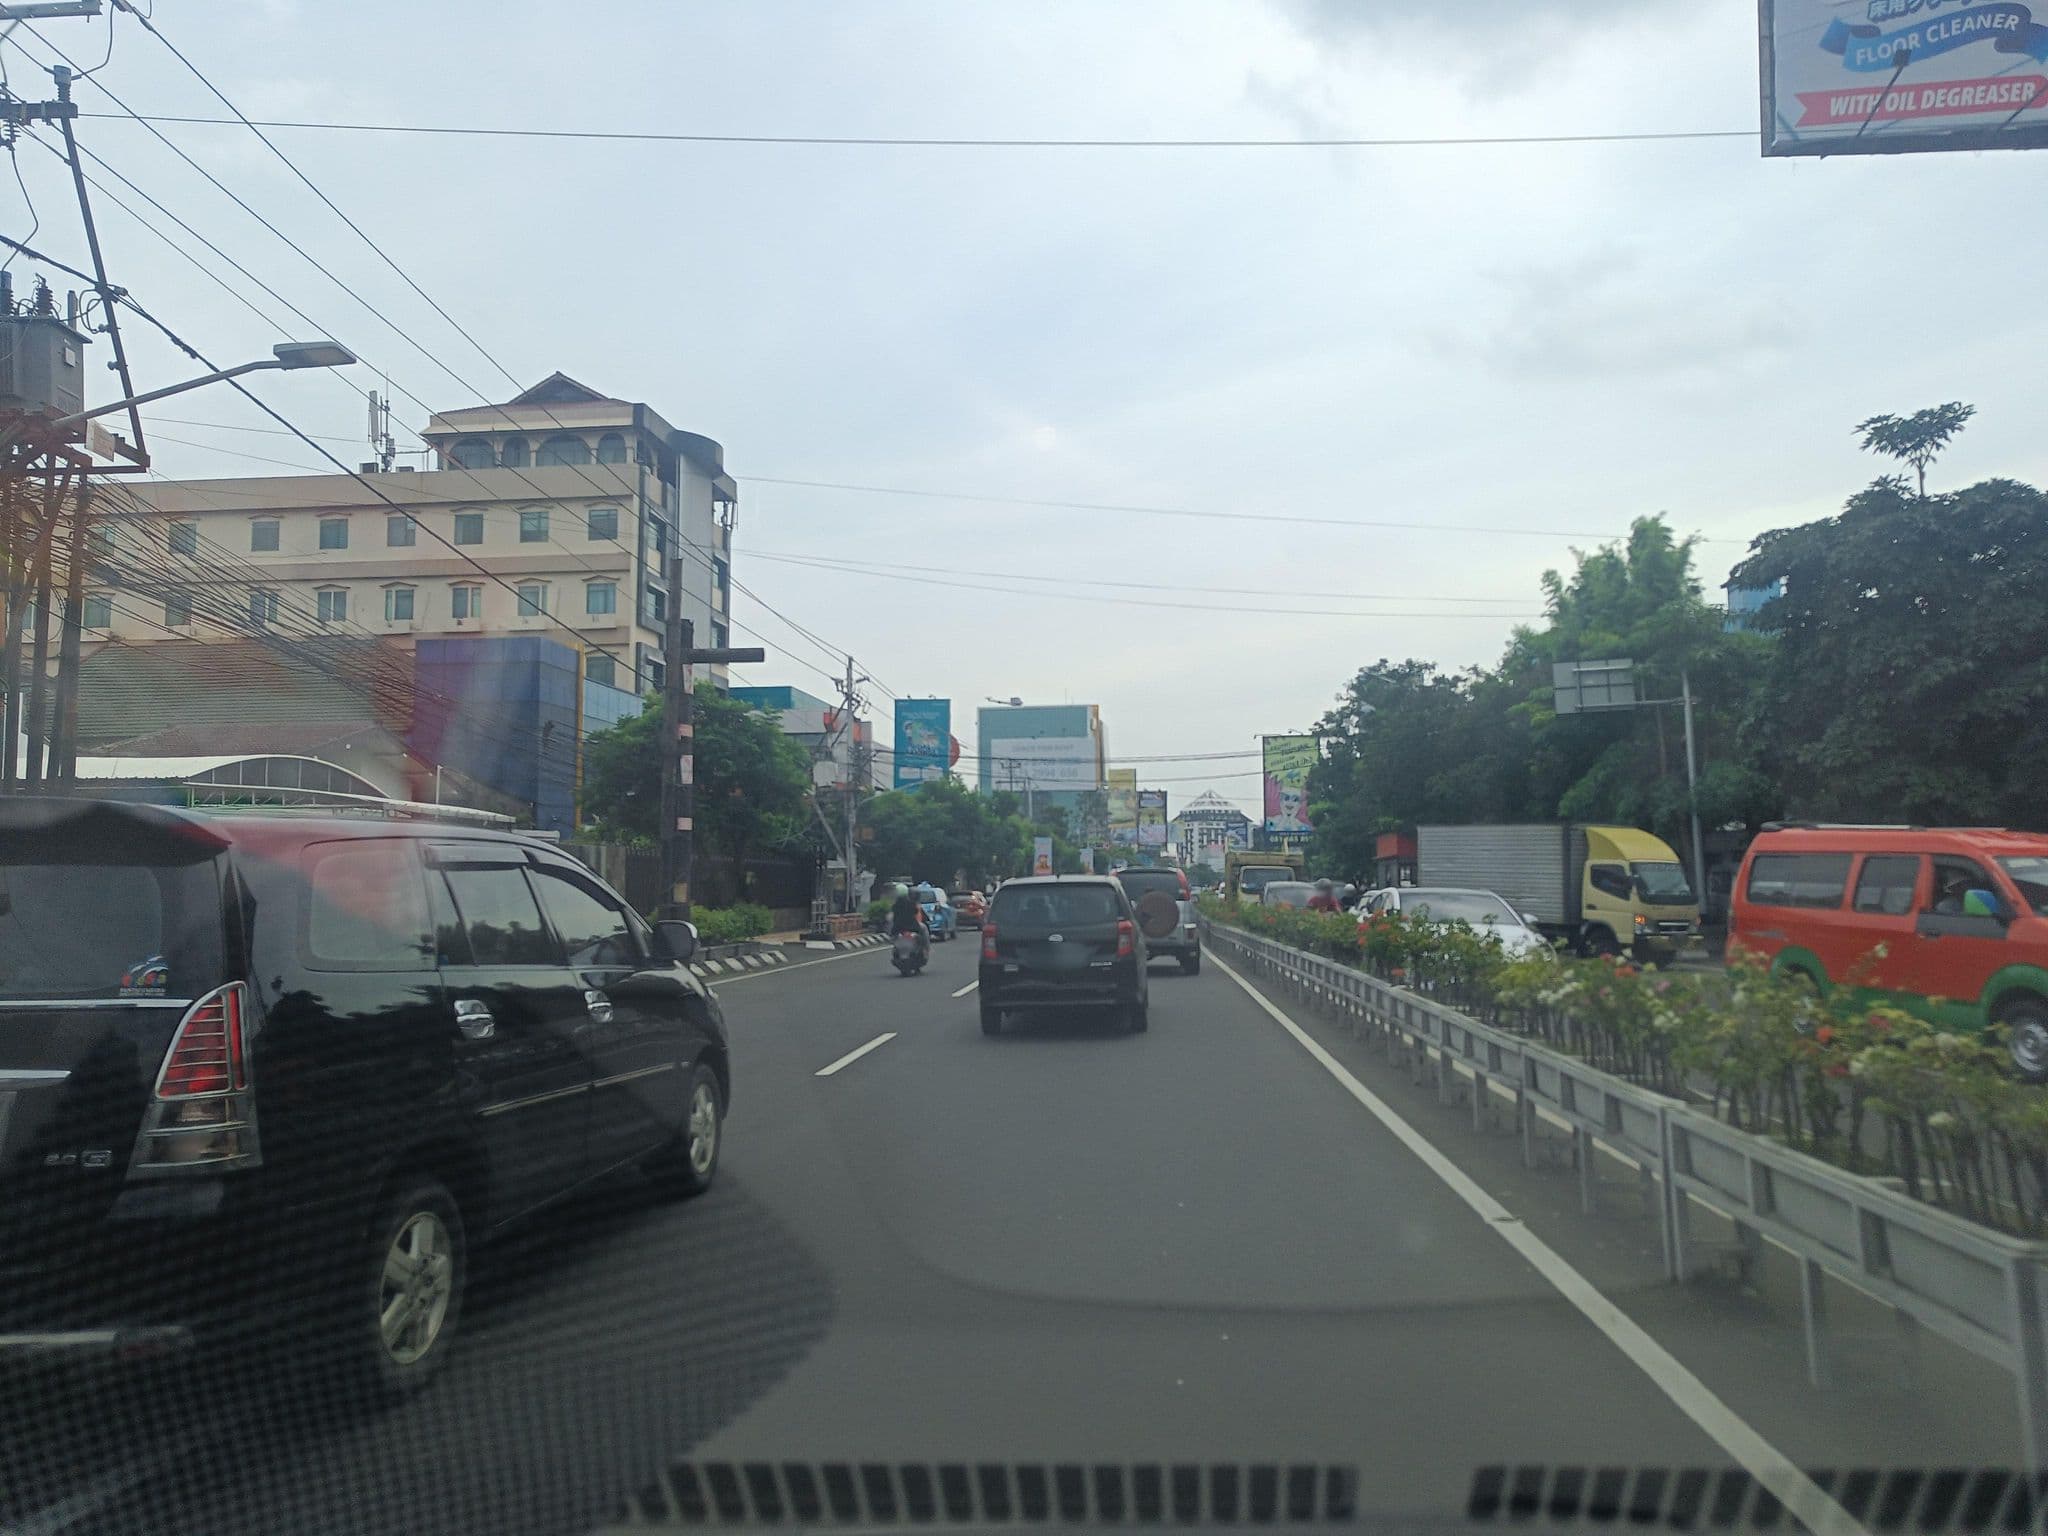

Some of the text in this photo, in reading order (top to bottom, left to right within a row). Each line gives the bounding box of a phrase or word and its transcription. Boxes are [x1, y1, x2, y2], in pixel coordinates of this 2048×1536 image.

[1855, 13, 2020, 66] FLOOR CLEANER
[1830, 82, 2036, 117] WITH OIL DEGREASER
